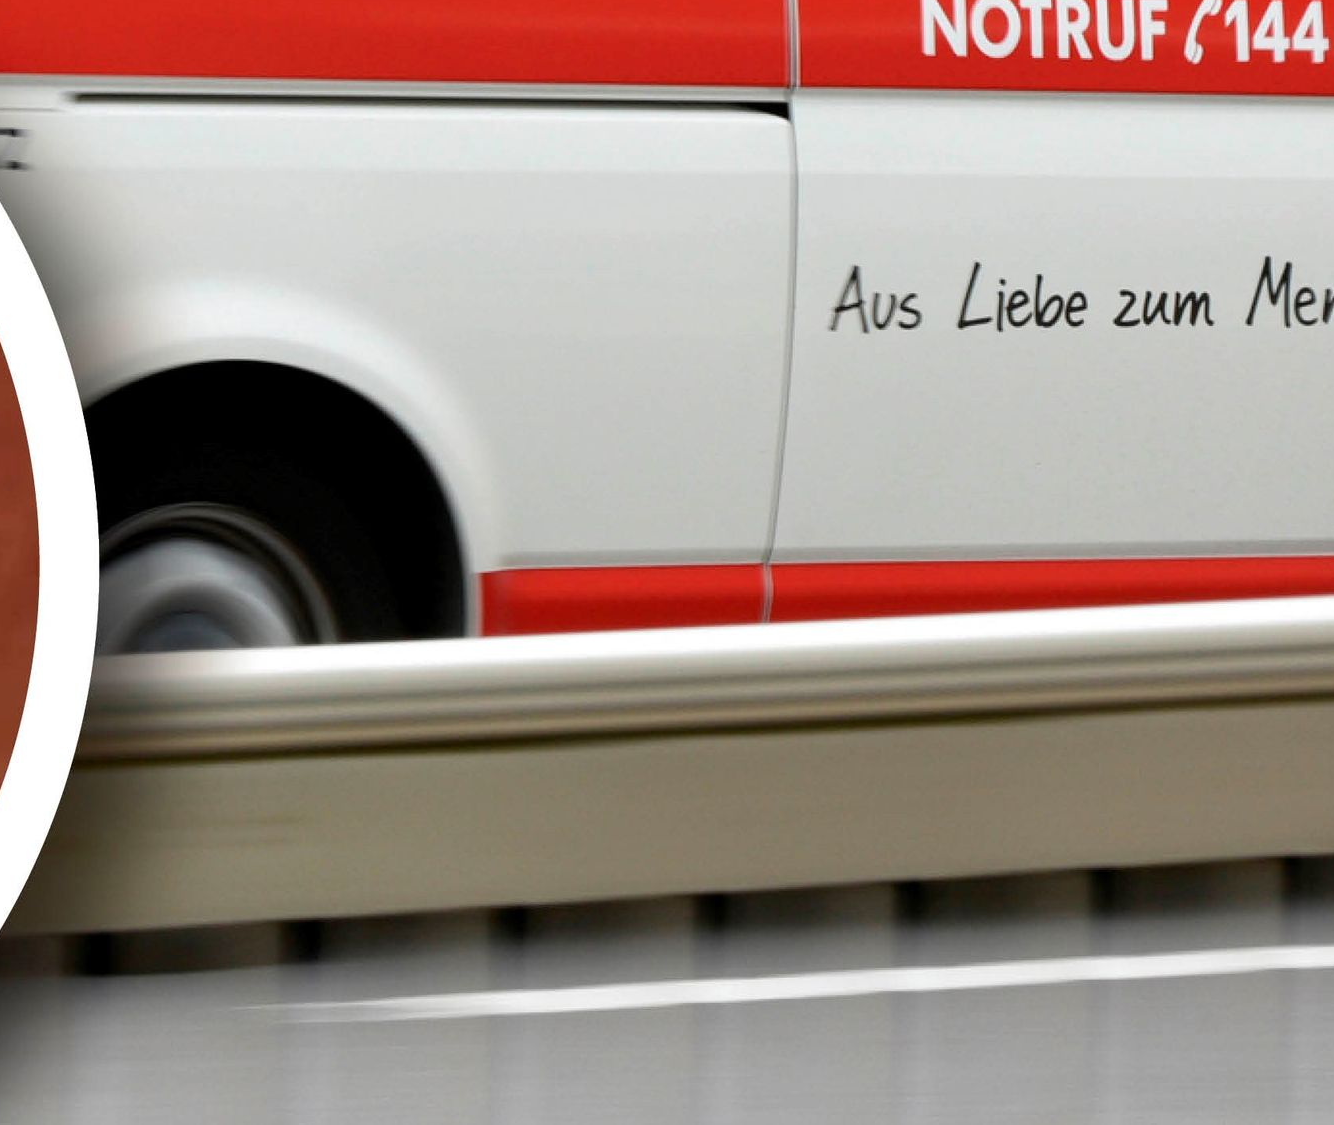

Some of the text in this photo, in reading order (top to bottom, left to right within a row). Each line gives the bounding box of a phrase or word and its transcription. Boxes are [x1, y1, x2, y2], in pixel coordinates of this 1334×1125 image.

[1225, 0, 1329, 64] 144
[828, 266, 924, 333] Aus
[958, 262, 1089, 331] Liebe
[1113, 286, 1215, 327] zum
